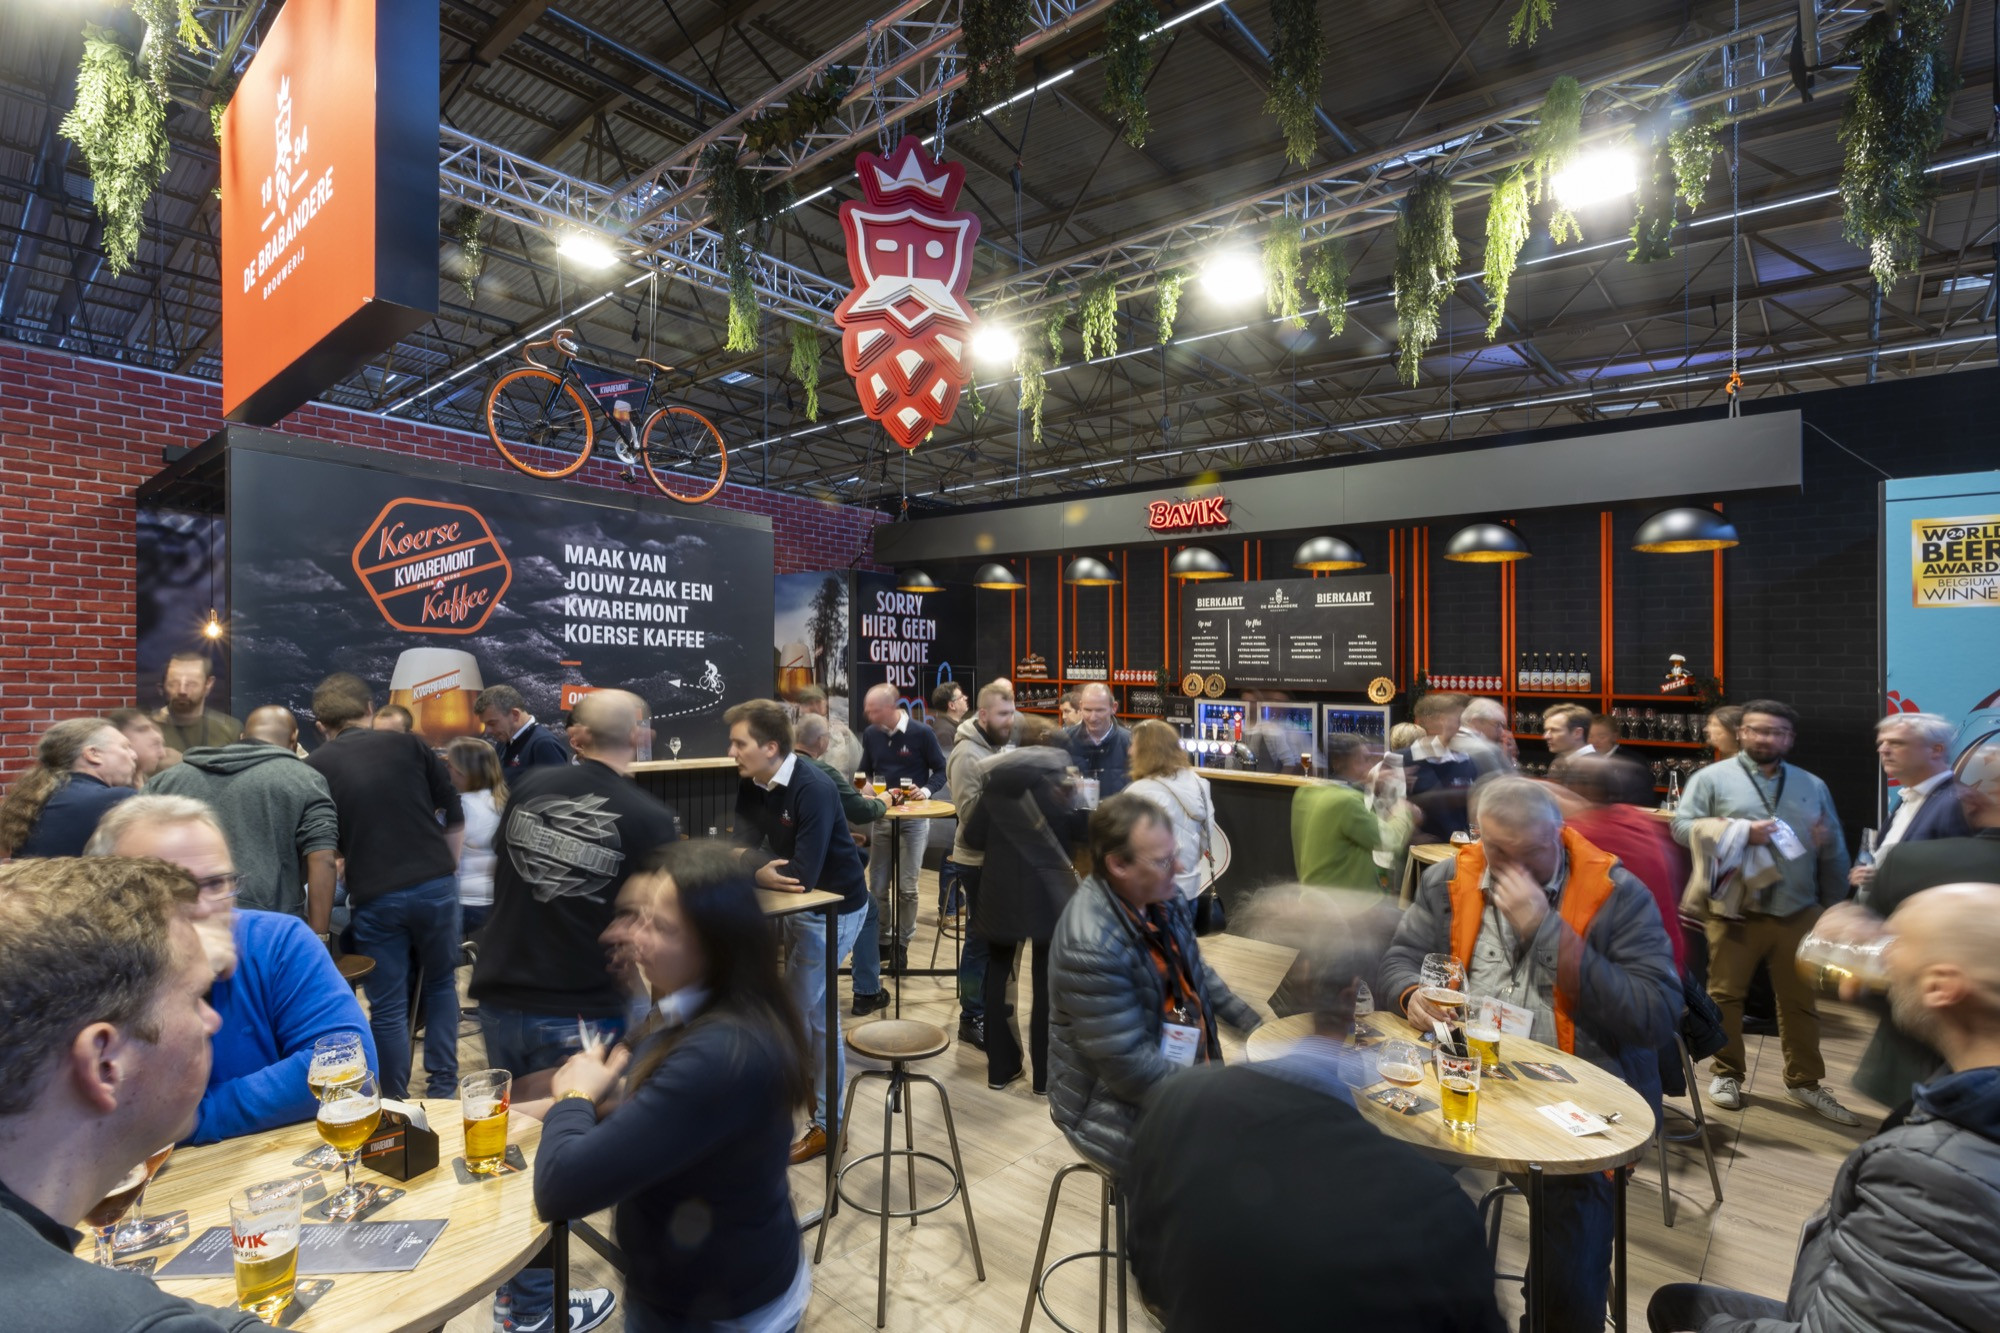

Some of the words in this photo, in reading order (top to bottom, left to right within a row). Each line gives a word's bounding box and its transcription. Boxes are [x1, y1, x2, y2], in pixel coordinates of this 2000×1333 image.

[294, 125, 308, 165] 94
[261, 175, 272, 208] 18
[244, 259, 256, 294] DE
[258, 165, 334, 277] BRABANDERE
[263, 246, 305, 300] BROUWERIJ
[600, 382, 629, 395] KWAREMONT
[1149, 496, 1228, 529] BAVIK
[378, 520, 461, 560] Koerse
[1922, 540, 2000, 563] BEER
[394, 547, 476, 588] KWAREMONT
[565, 544, 624, 569] MAAK
[629, 551, 667, 574] VAN
[1923, 562, 2000, 575] AWARD
[564, 571, 625, 595] JOUW
[628, 577, 677, 599] ZAAK
[681, 582, 713, 602] EEN
[1938, 577, 1995, 588] BELGIUM
[422, 583, 490, 624] Kaffee
[565, 597, 689, 624] KWAREMONT
[876, 591, 923, 616] SORRY
[1197, 596, 1244, 607] BIERKAART
[1316, 591, 1372, 604] BIERKAART
[565, 623, 639, 646] KOERSE
[643, 628, 705, 649] KAFFEE
[862, 614, 897, 638] HIER
[902, 618, 936, 641] GEEN
[870, 640, 929, 664] GEWONE
[886, 665, 916, 688] PILS
[370, 1137, 395, 1153] KWAREMONT
[231, 1232, 268, 1249] AVIK
